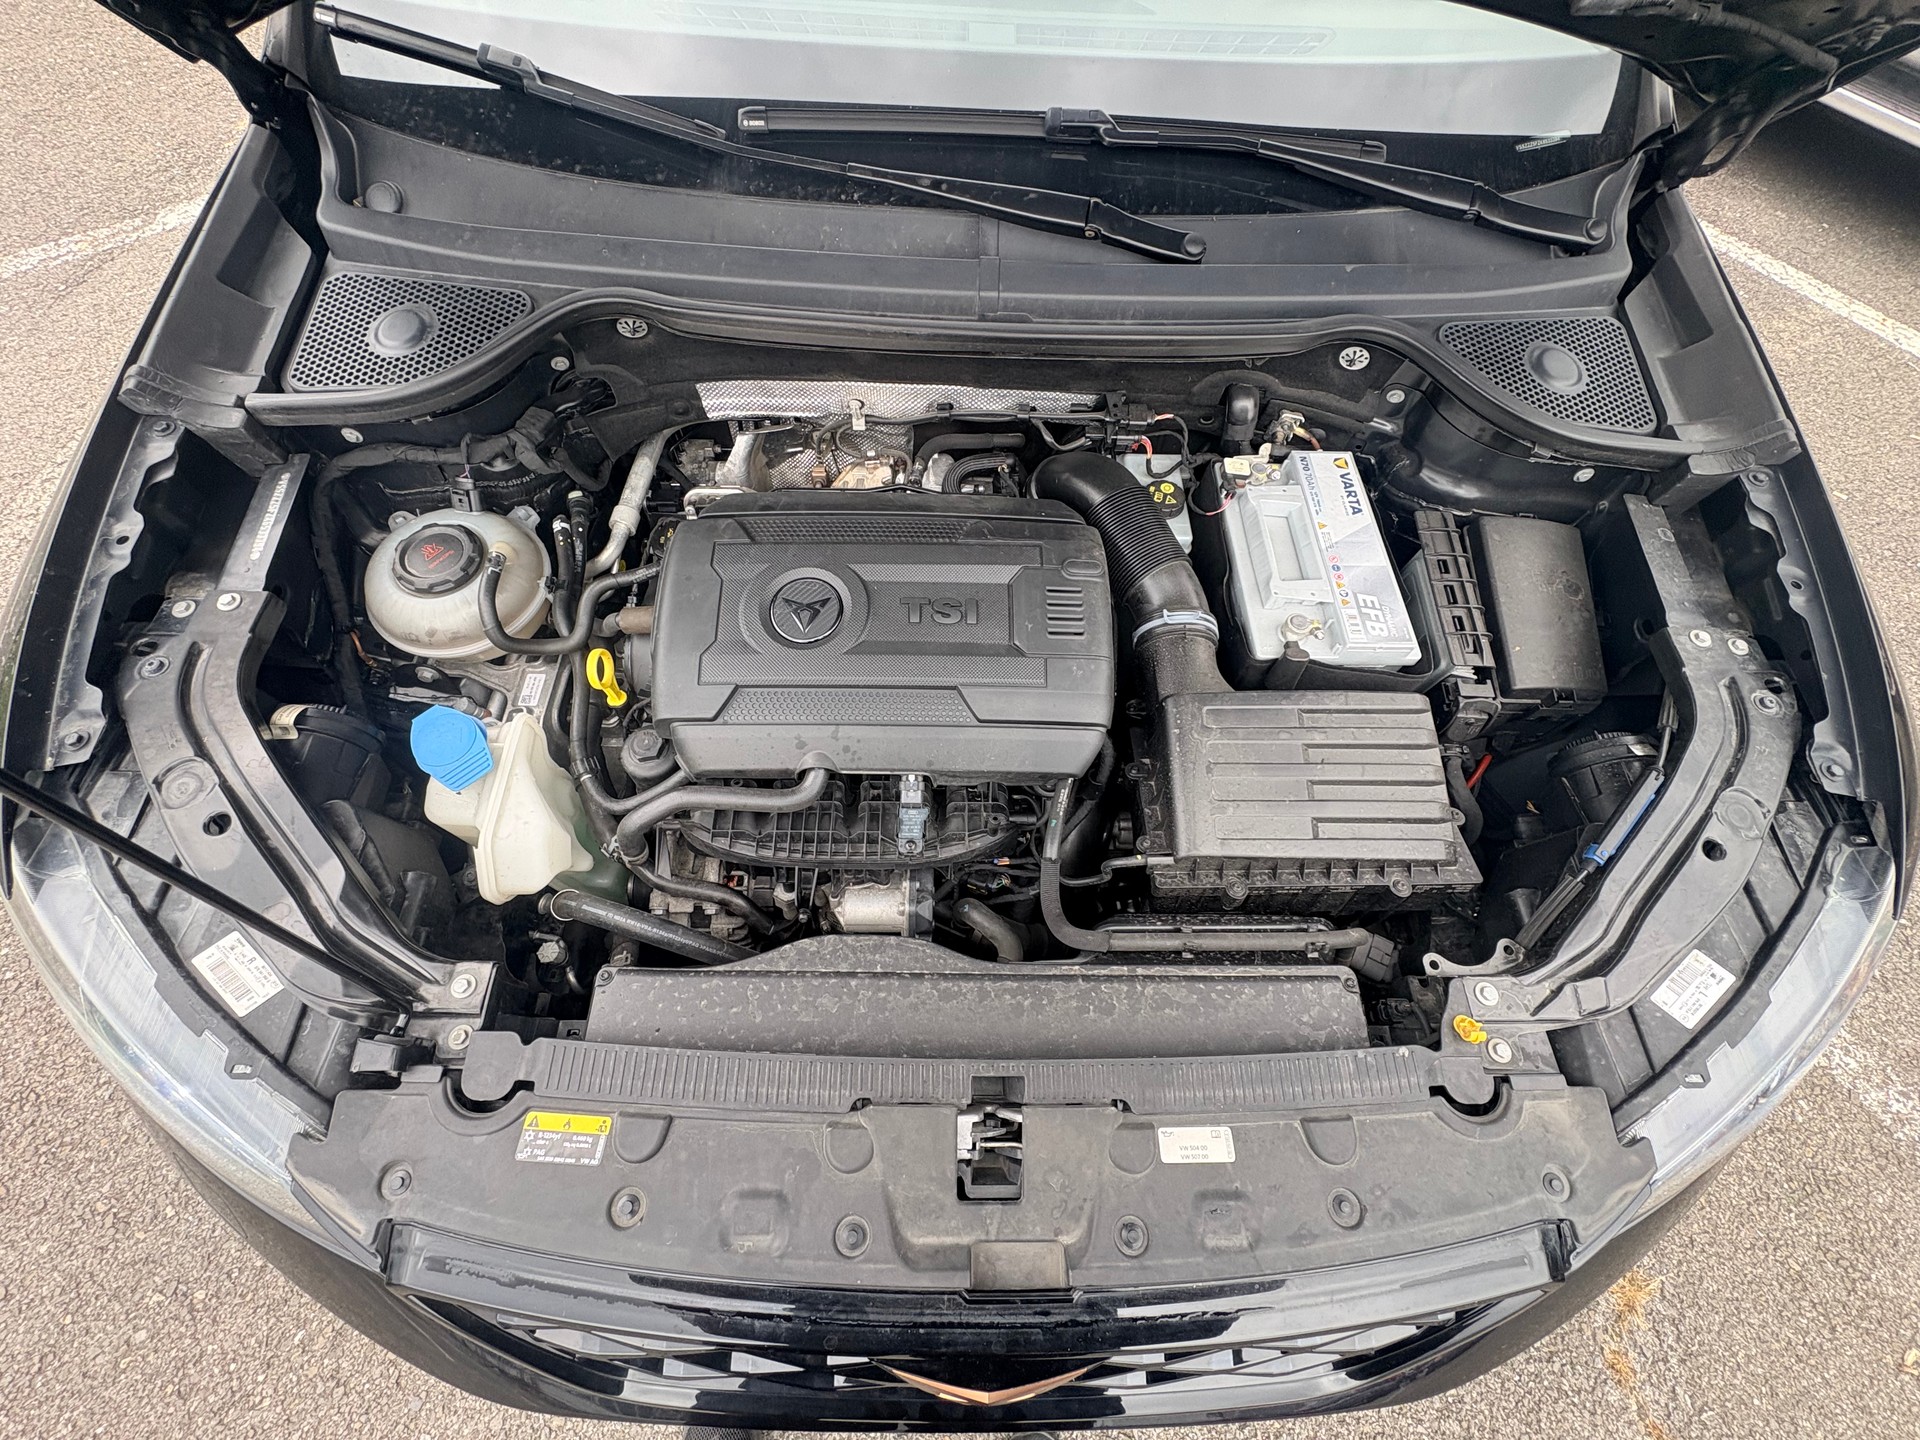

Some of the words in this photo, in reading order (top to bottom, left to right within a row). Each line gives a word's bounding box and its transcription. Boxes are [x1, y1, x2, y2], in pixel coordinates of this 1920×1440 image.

[1299, 456, 1310, 472] N70
[1306, 471, 1316, 492] 70Ah
[1339, 473, 1362, 516] VARTA
[900, 597, 979, 625] TSI
[1357, 593, 1388, 638] EFB
[1382, 605, 1398, 638] DYNAMIC
[247, 956, 256, 965] R
